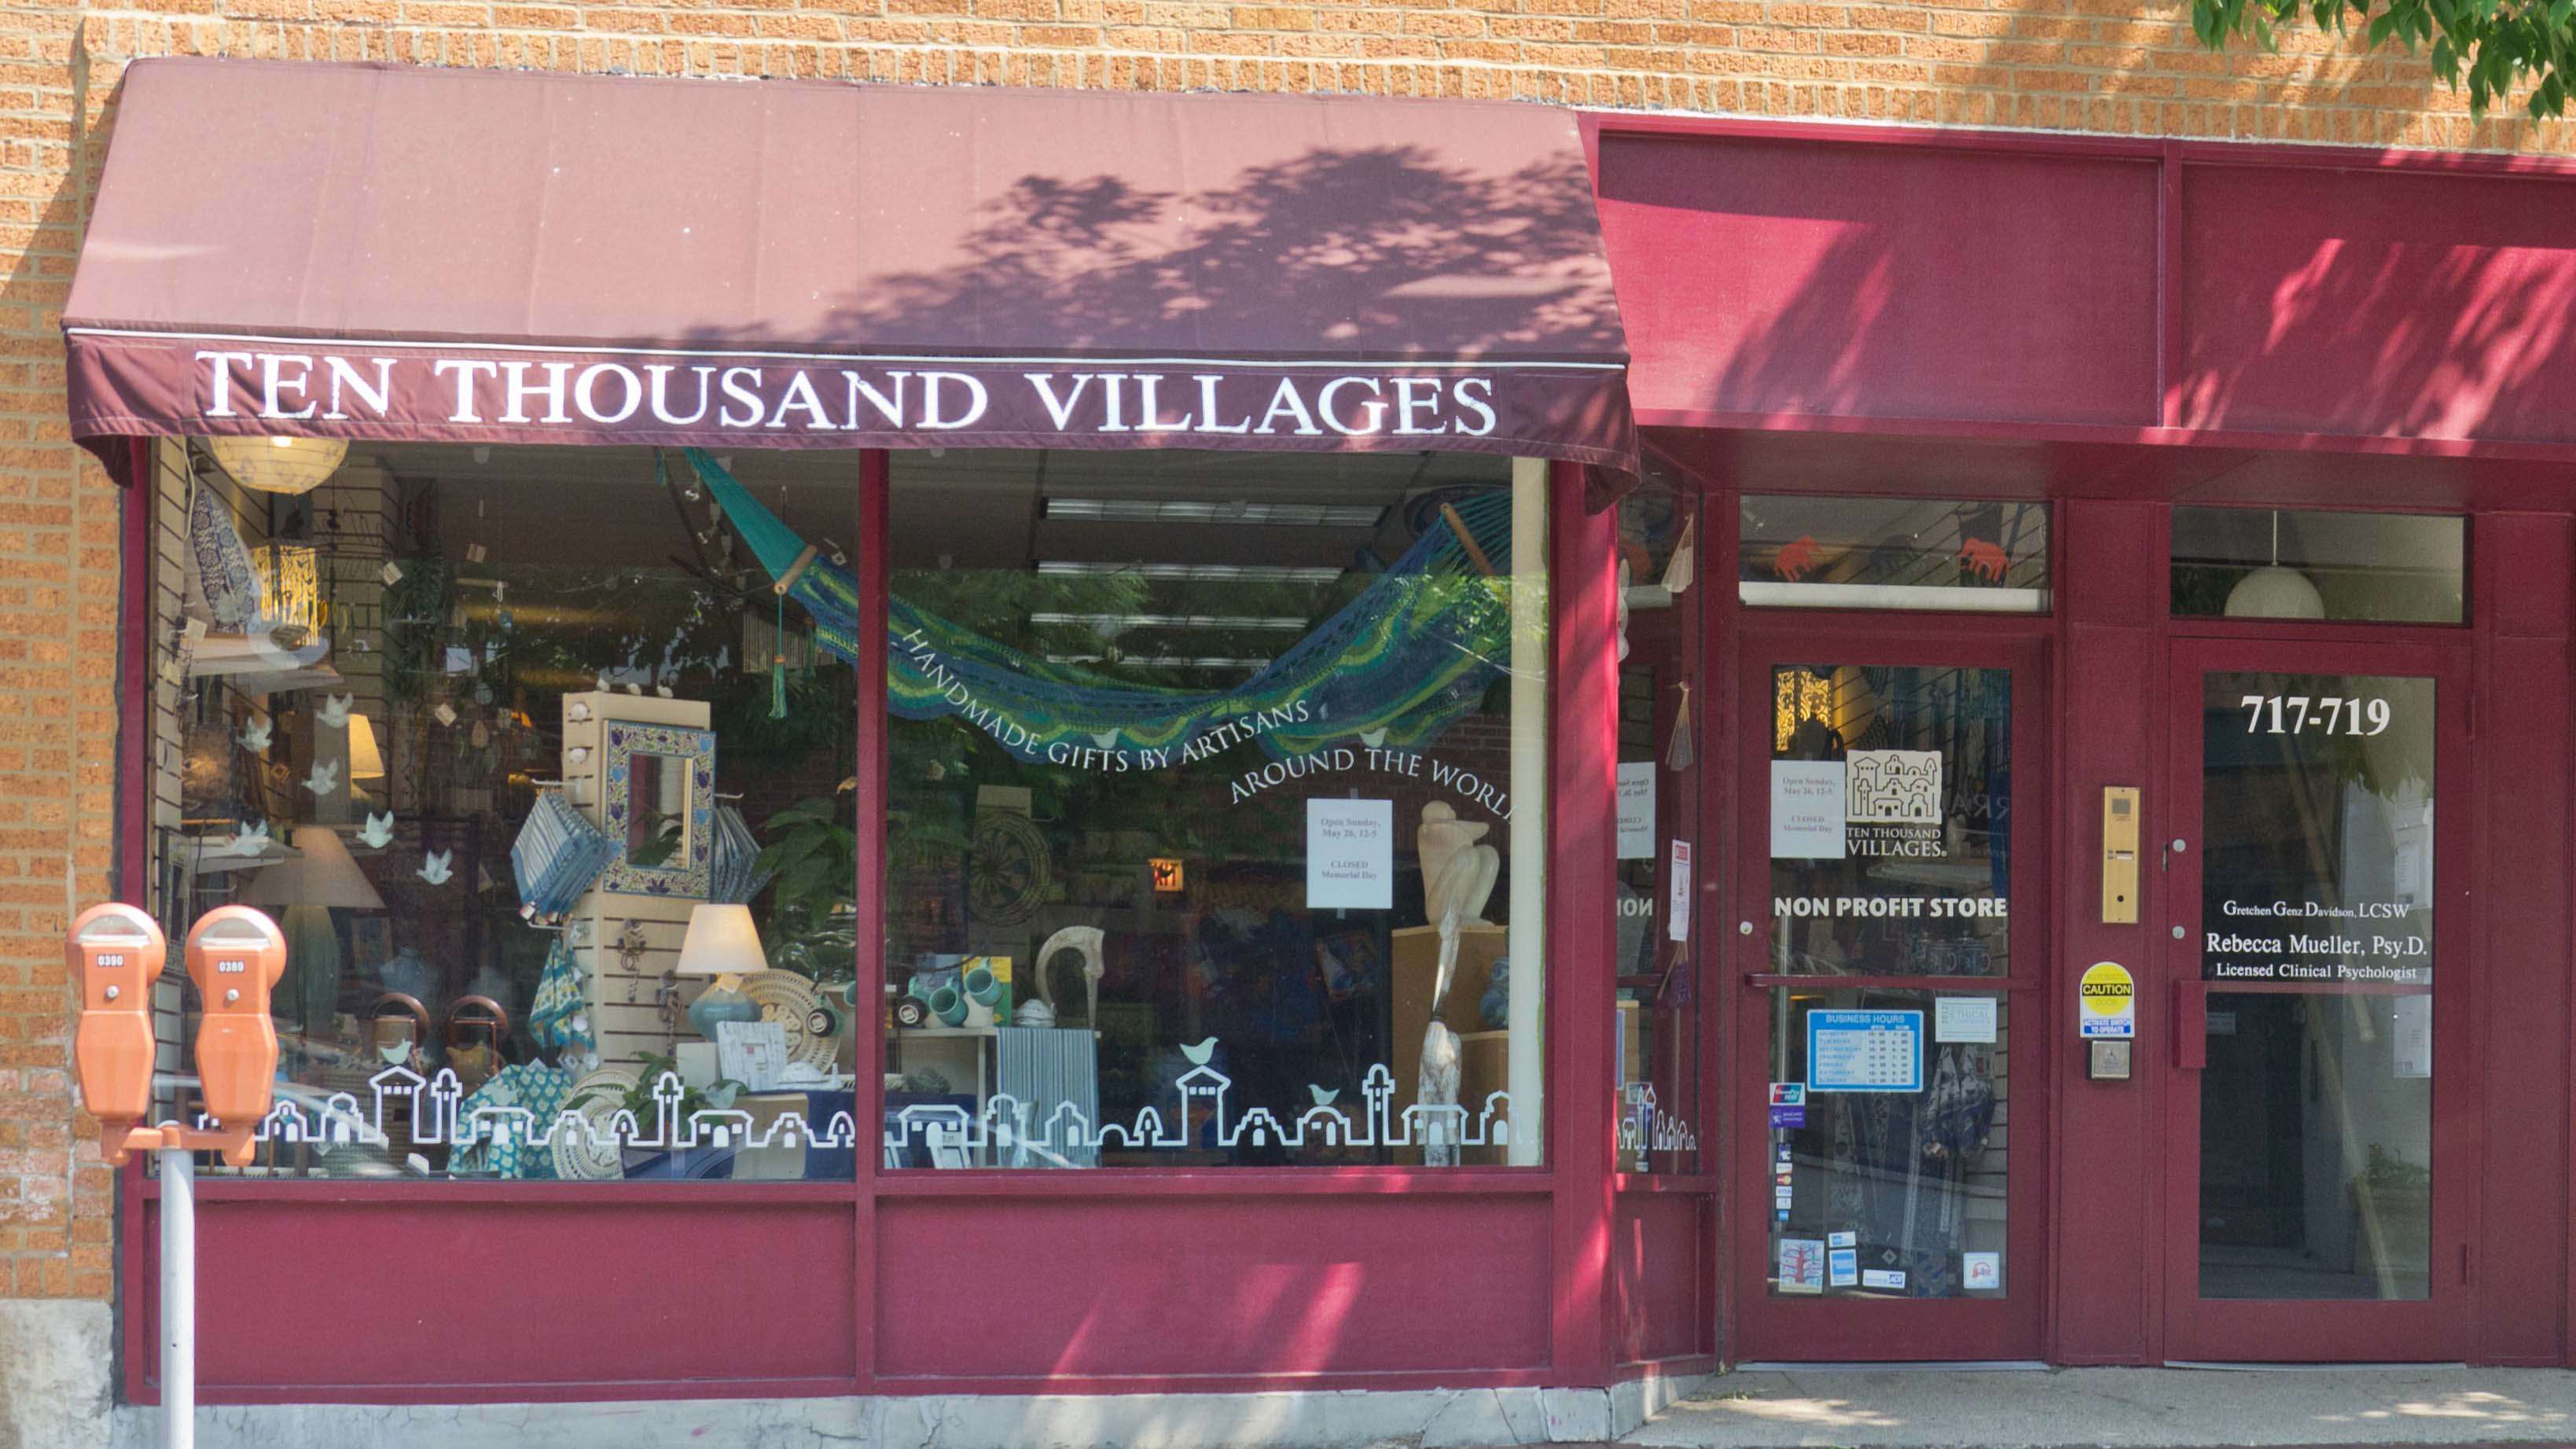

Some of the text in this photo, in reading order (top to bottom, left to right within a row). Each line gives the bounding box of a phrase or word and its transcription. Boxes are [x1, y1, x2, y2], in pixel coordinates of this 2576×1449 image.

[195, 350, 1497, 437] TEN THOUSAND VILLAGES
[902, 628, 1309, 773] HANDMADE GIFTS BY ARTISANS
[2240, 695, 2390, 736] 717-719
[1229, 748, 1354, 804] AROUND
[1364, 748, 1422, 778] THE
[1321, 818, 1344, 827] Open
[1321, 829, 1341, 840] May
[1847, 826, 1942, 839] TEN THOUSAND
[1321, 870, 1377, 881] Memorial Day
[1774, 896, 2008, 918] NON PROFIT STORE
[2223, 899, 2411, 918] Gretchen Genz Davidson, LCSW
[2207, 932, 2427, 958] Rebecca Mueller, Psy.D.
[2216, 962, 2417, 981] Licensed Clinical Psychologist
[2082, 984, 2132, 995] CAUTION
[1825, 1014, 1906, 1024] BUSINESS HOURS
